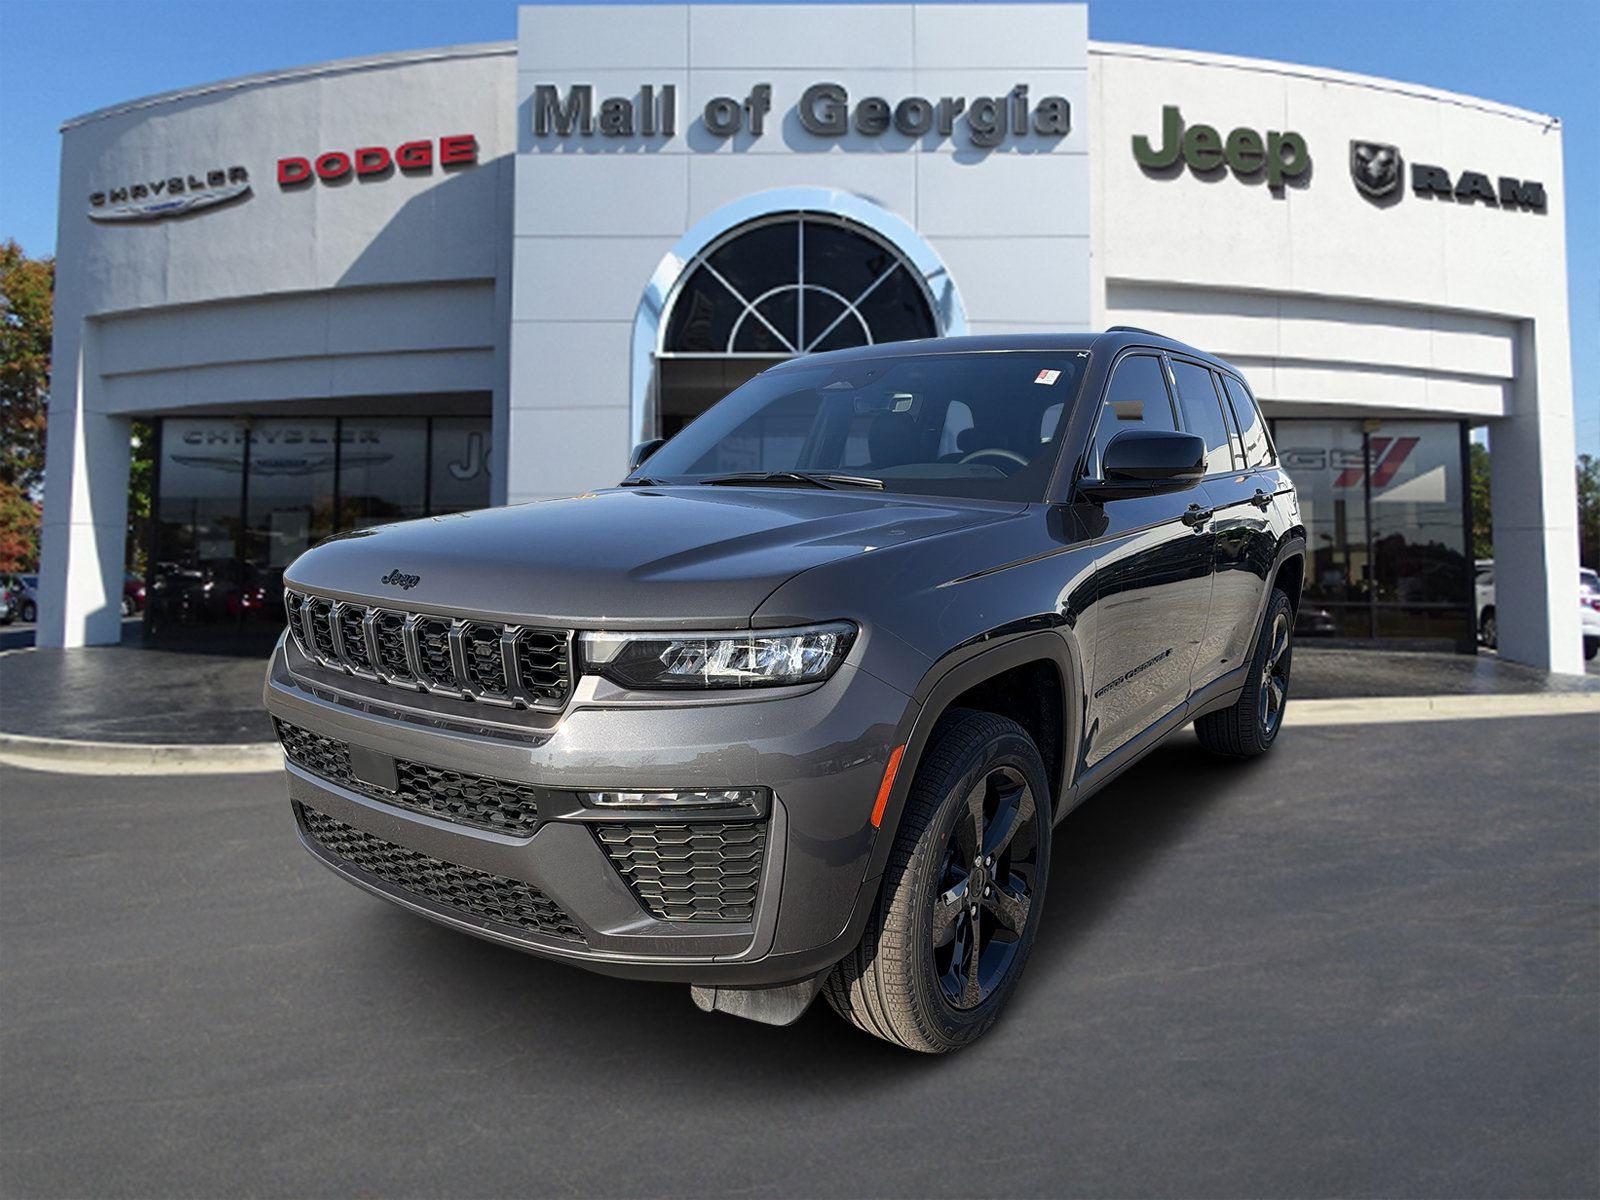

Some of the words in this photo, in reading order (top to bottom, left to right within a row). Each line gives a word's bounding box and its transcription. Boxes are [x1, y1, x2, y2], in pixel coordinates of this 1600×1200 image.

[533, 84, 675, 136] Mall
[703, 83, 772, 136] of
[798, 83, 1071, 148] Georgia
[277, 134, 478, 190] DODGE
[1131, 104, 1310, 198] Jeep
[89, 165, 249, 207] CHRYSLER
[1411, 162, 1548, 214] RAM
[382, 568, 420, 591] Jeep
